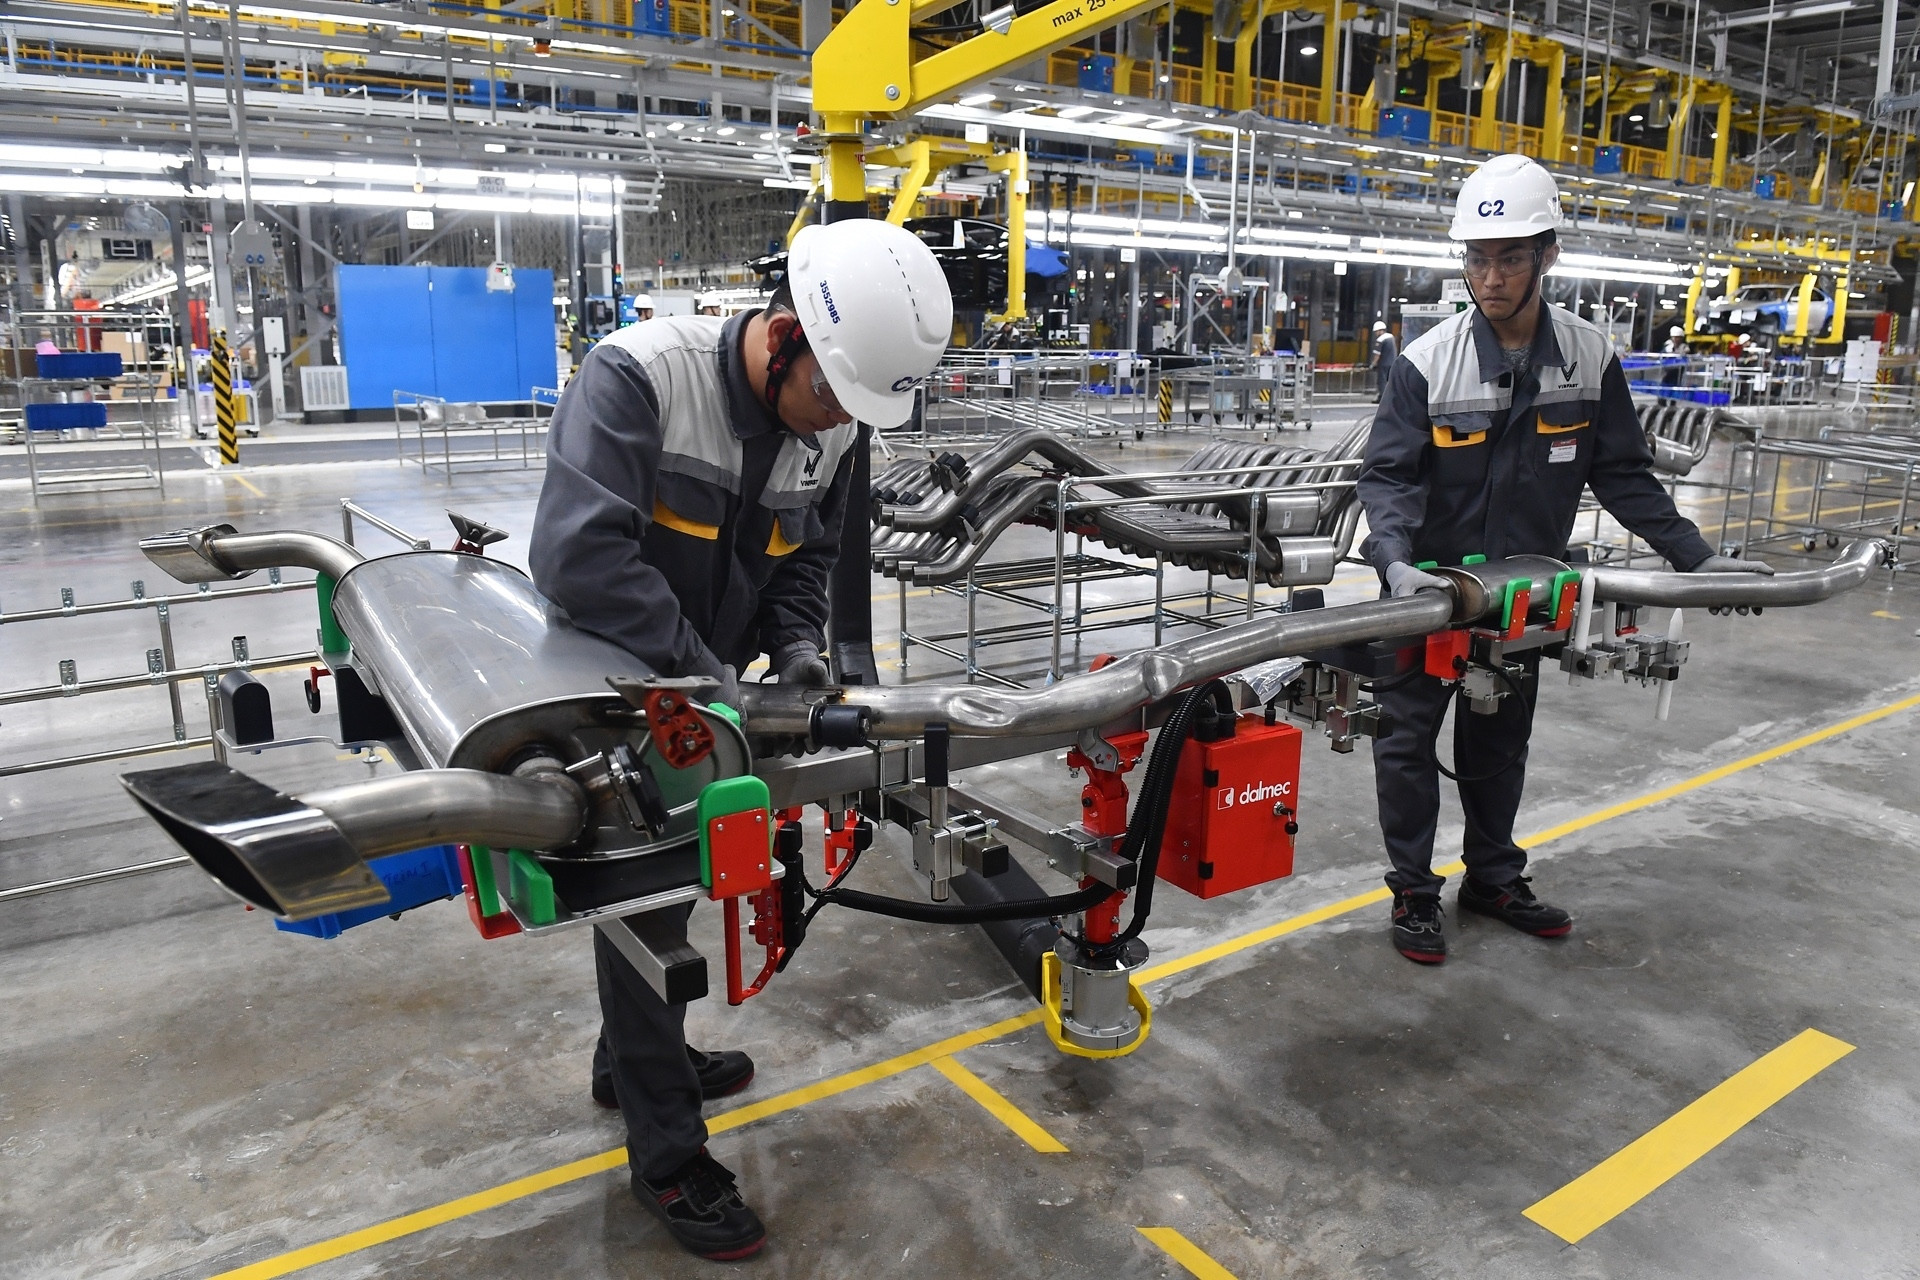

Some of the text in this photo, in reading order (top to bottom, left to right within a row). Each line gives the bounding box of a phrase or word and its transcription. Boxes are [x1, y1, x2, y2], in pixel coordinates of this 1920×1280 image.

[1052, 8, 1083, 27] max
[1478, 199, 1505, 218] C2
[820, 280, 841, 324] 3552985
[1239, 780, 1291, 805] dalmec
